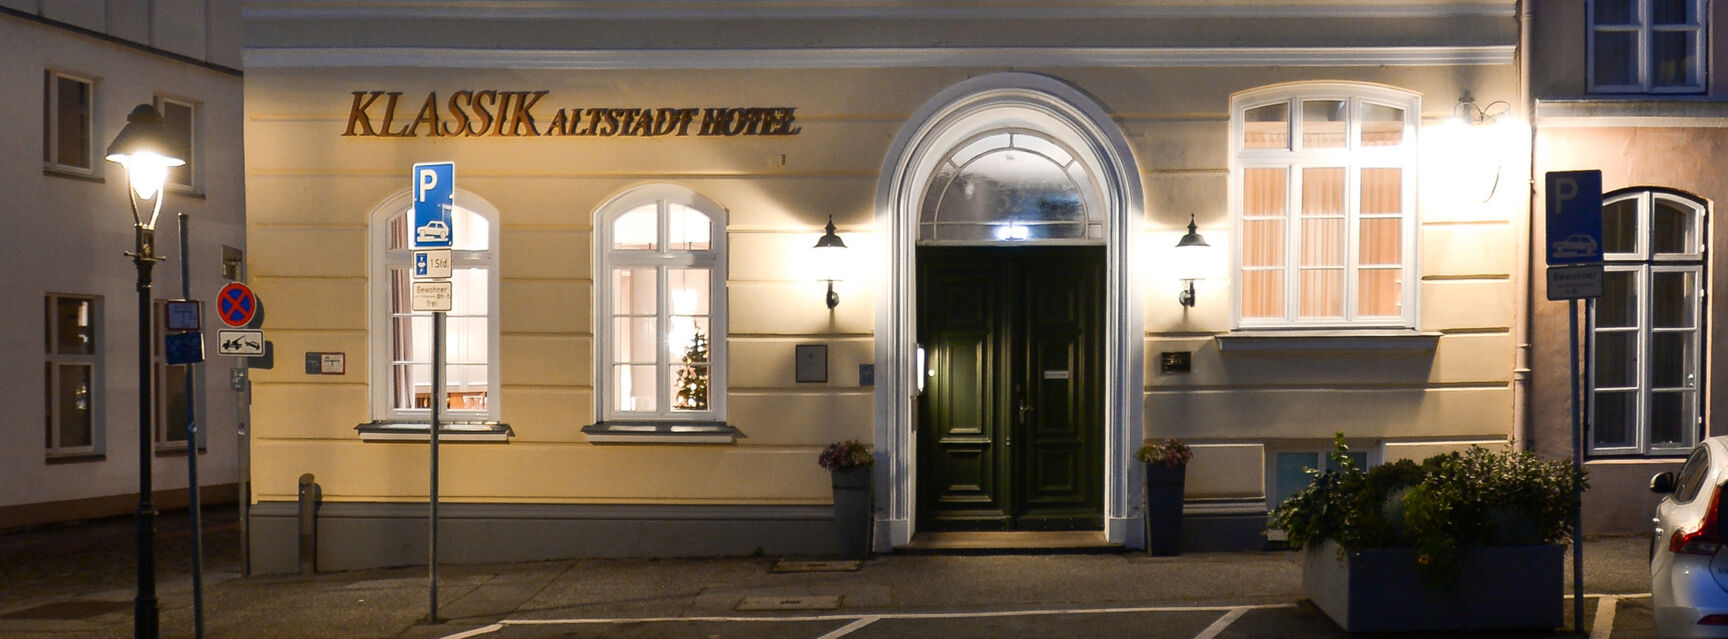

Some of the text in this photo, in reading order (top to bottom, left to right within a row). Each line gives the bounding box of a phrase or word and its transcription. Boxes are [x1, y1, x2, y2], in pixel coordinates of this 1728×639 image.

[341, 90, 800, 137] KLASSIK ALTSTADT HOTEL
[420, 169, 438, 202] P
[1556, 178, 1579, 214] P
[416, 286, 447, 294] Bewohner
